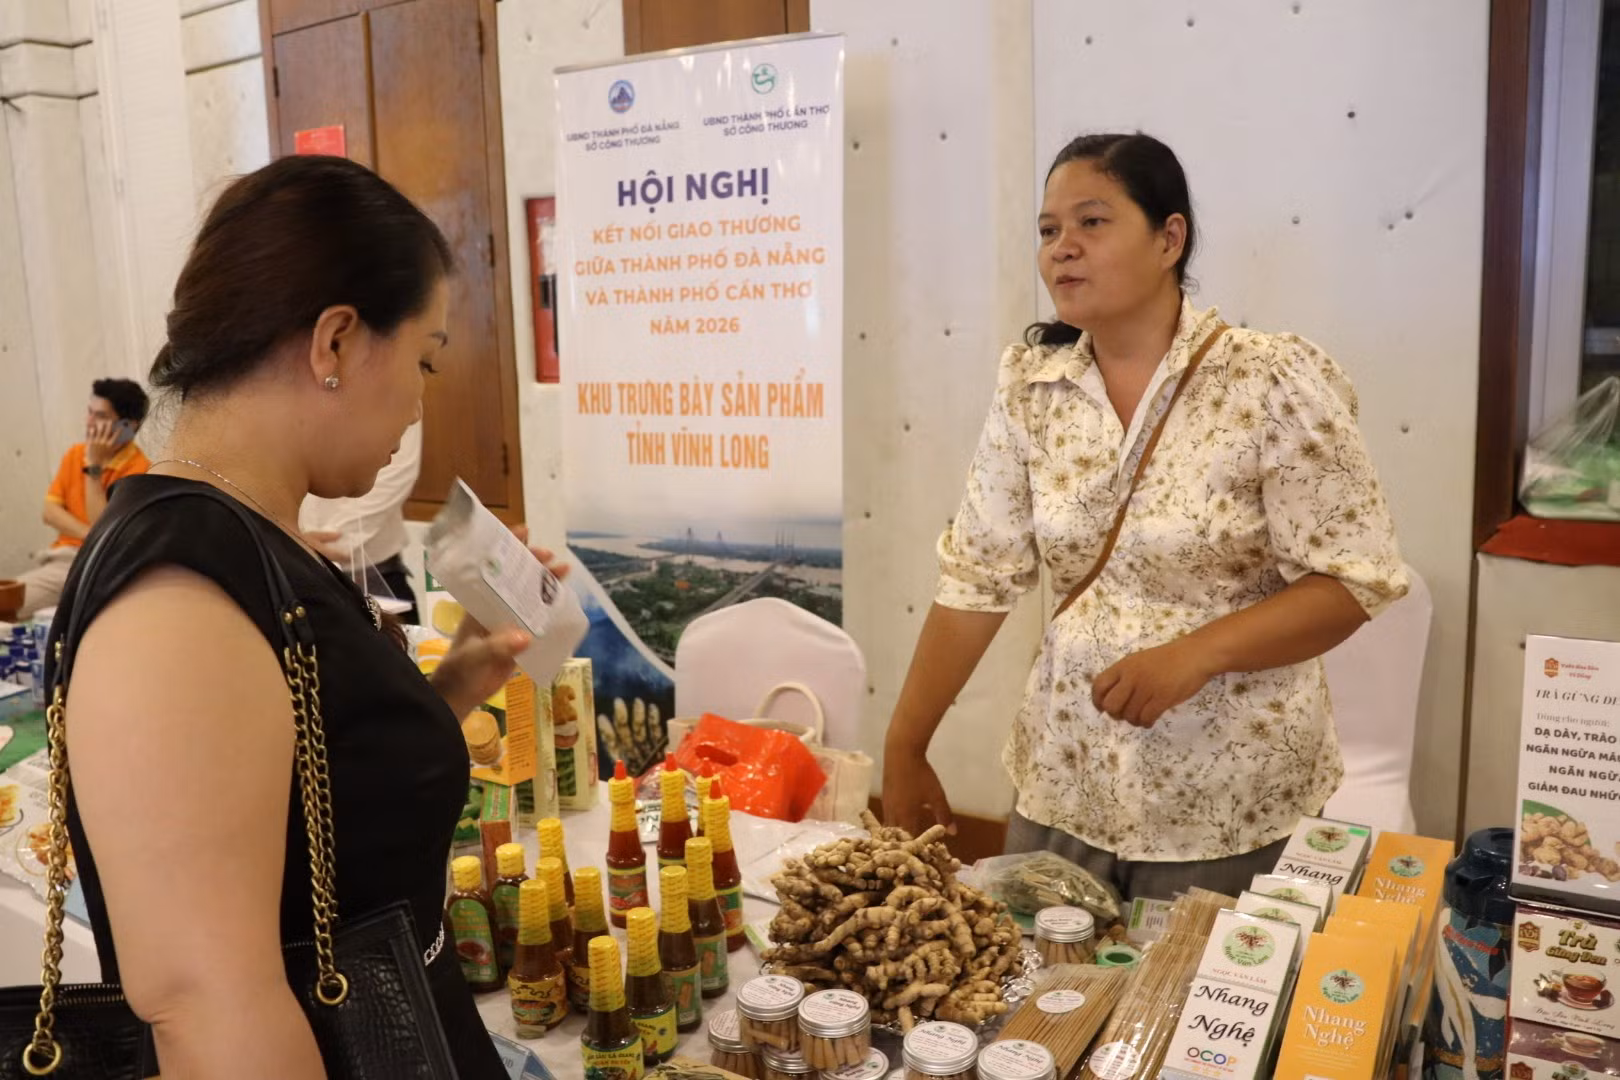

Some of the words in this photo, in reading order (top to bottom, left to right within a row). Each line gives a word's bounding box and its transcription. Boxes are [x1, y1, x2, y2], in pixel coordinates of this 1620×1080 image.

[703, 116, 729, 126] UBND
[731, 111, 762, 121] THÀNH
[723, 125, 737, 136] SỞ
[738, 122, 765, 135] CÔNG
[767, 119, 808, 132] THƯƠNG
[618, 170, 674, 213] HỘI
[685, 167, 769, 205] NGHỊ
[593, 221, 625, 245] KẾT
[629, 219, 662, 242] NỐI
[667, 220, 713, 240] GIAO
[719, 214, 801, 236] THƯƠNG
[575, 256, 616, 276] GIỮA
[621, 250, 681, 274] THÀNH
[687, 246, 729, 270] PHỐ
[734, 246, 762, 268] ĐÀ
[767, 242, 826, 266] NẴNG
[585, 285, 609, 305] VÀ
[614, 284, 674, 305] THÀNH
[680, 279, 720, 302] PHỐ
[725, 278, 766, 301] CẦN
[771, 280, 813, 299] THƠ
[650, 315, 690, 335] NĂM
[695, 317, 741, 334] 2026
[577, 382, 613, 415] KHU
[617, 380, 674, 416] TRƯNG
[679, 375, 714, 417] BÀY
[721, 370, 761, 417] SẢN
[767, 368, 824, 418] PHẨM
[626, 421, 666, 465] TỈNH
[671, 426, 713, 467] VĨNH
[720, 434, 769, 469] LONG
[1534, 727, 1551, 738] DẠ
[1554, 728, 1581, 741] DÀY,
[1584, 732, 1617, 744] TRÀO
[1526, 744, 1559, 755] NGĂN
[1562, 748, 1596, 760] NGỪA
[1549, 765, 1585, 778] NGĂN
[1528, 781, 1559, 793] GIẢM
[1561, 786, 1587, 797] ĐAU
[1280, 862, 1344, 886] Nhang
[1374, 877, 1427, 897] Nhang
[1558, 928, 1598, 951] Trà
[1194, 985, 1270, 1017] Nhang
[1187, 1014, 1256, 1047] Nghệ
[1304, 1005, 1368, 1036] Nhang
[1304, 1023, 1355, 1050] Nghệ
[1187, 1047, 1237, 1067] OCOP
